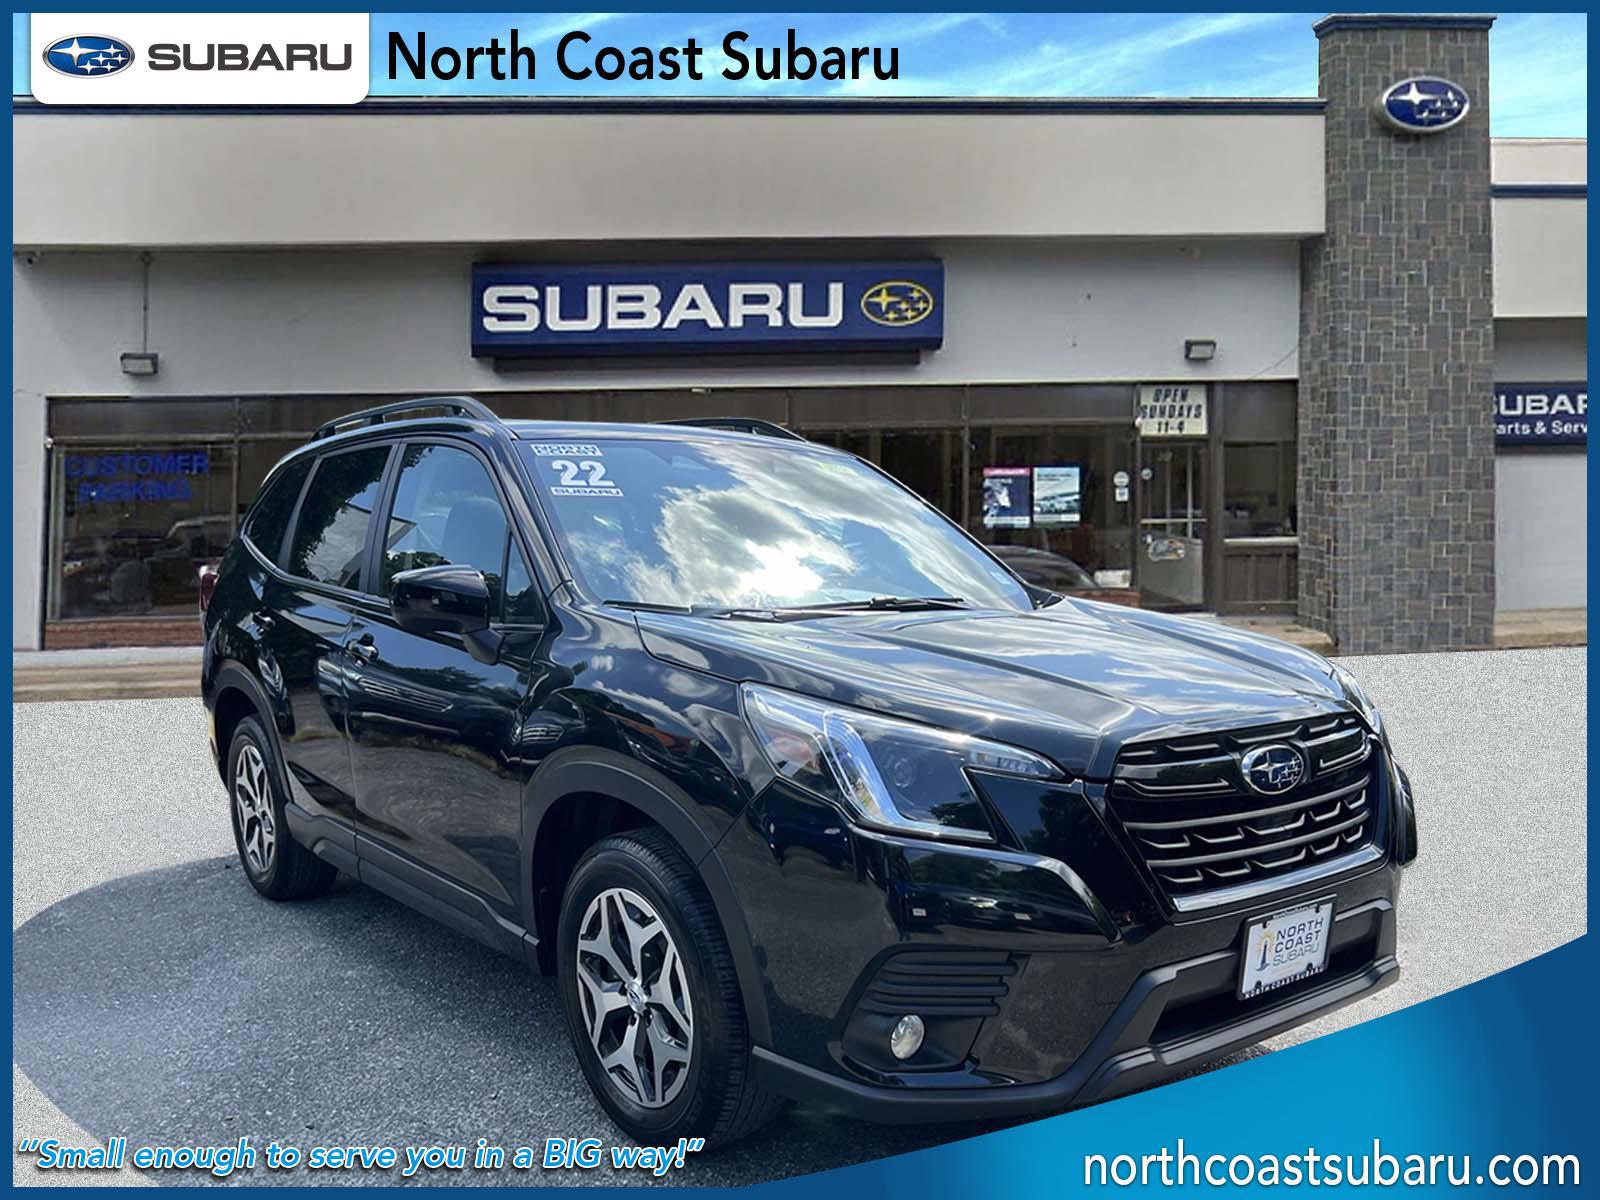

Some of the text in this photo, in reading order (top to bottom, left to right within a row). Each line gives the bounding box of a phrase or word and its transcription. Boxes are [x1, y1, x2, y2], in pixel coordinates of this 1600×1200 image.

[482, 281, 844, 333] SUBARU
[1153, 388, 1189, 403] OPEN
[1140, 404, 1202, 419] SUNDAYS
[1494, 421, 1531, 435] arts
[1534, 420, 1546, 435] &
[64, 451, 209, 478] CUSTOMER
[551, 459, 616, 487] 22
[553, 487, 621, 496] SUBARU
[1274, 929, 1321, 953] COAST
[1276, 917, 1324, 941] NORTH
[1272, 942, 1320, 966] SUBARU
